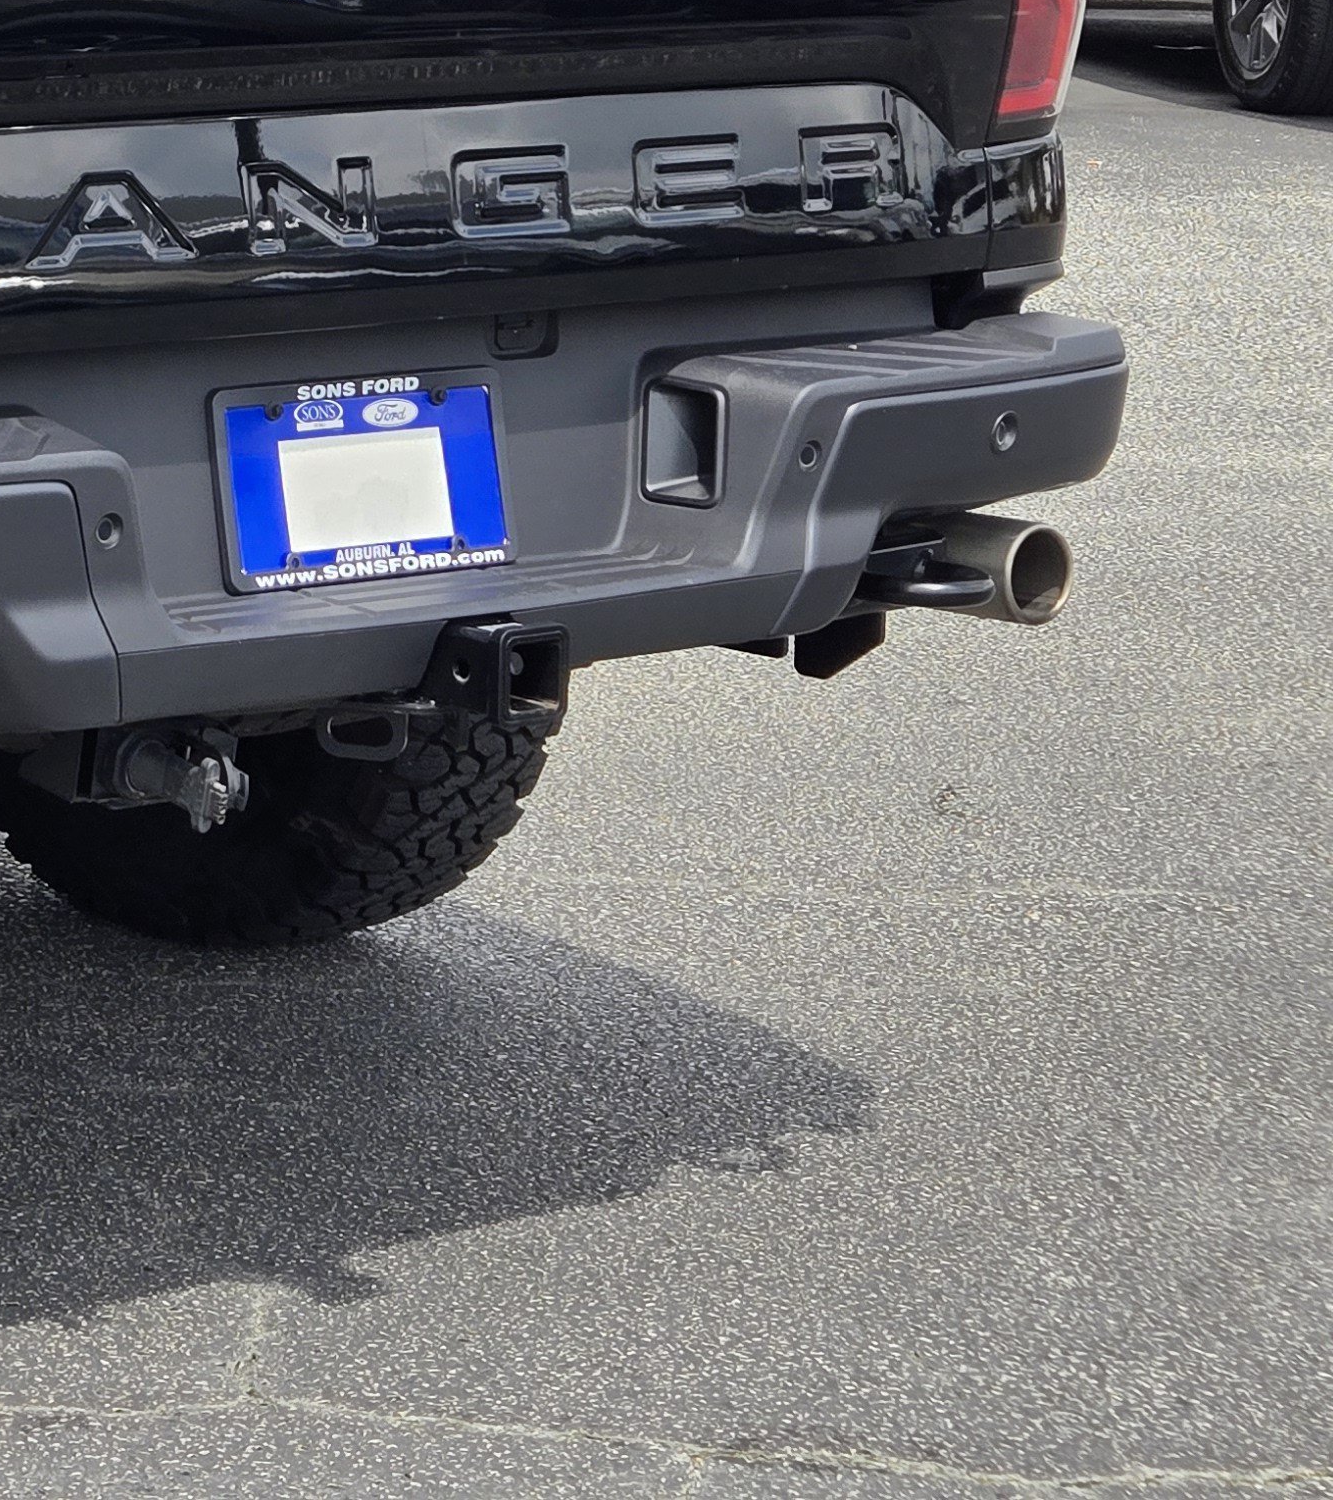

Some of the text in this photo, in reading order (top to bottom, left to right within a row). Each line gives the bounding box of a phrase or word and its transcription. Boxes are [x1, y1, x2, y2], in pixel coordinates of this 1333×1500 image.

[296, 376, 420, 401] SONS FORD
[301, 404, 336, 421] SONS
[374, 403, 406, 422] Ford
[397, 541, 415, 556] AL
[254, 548, 506, 589] www.SONSFORD.com
